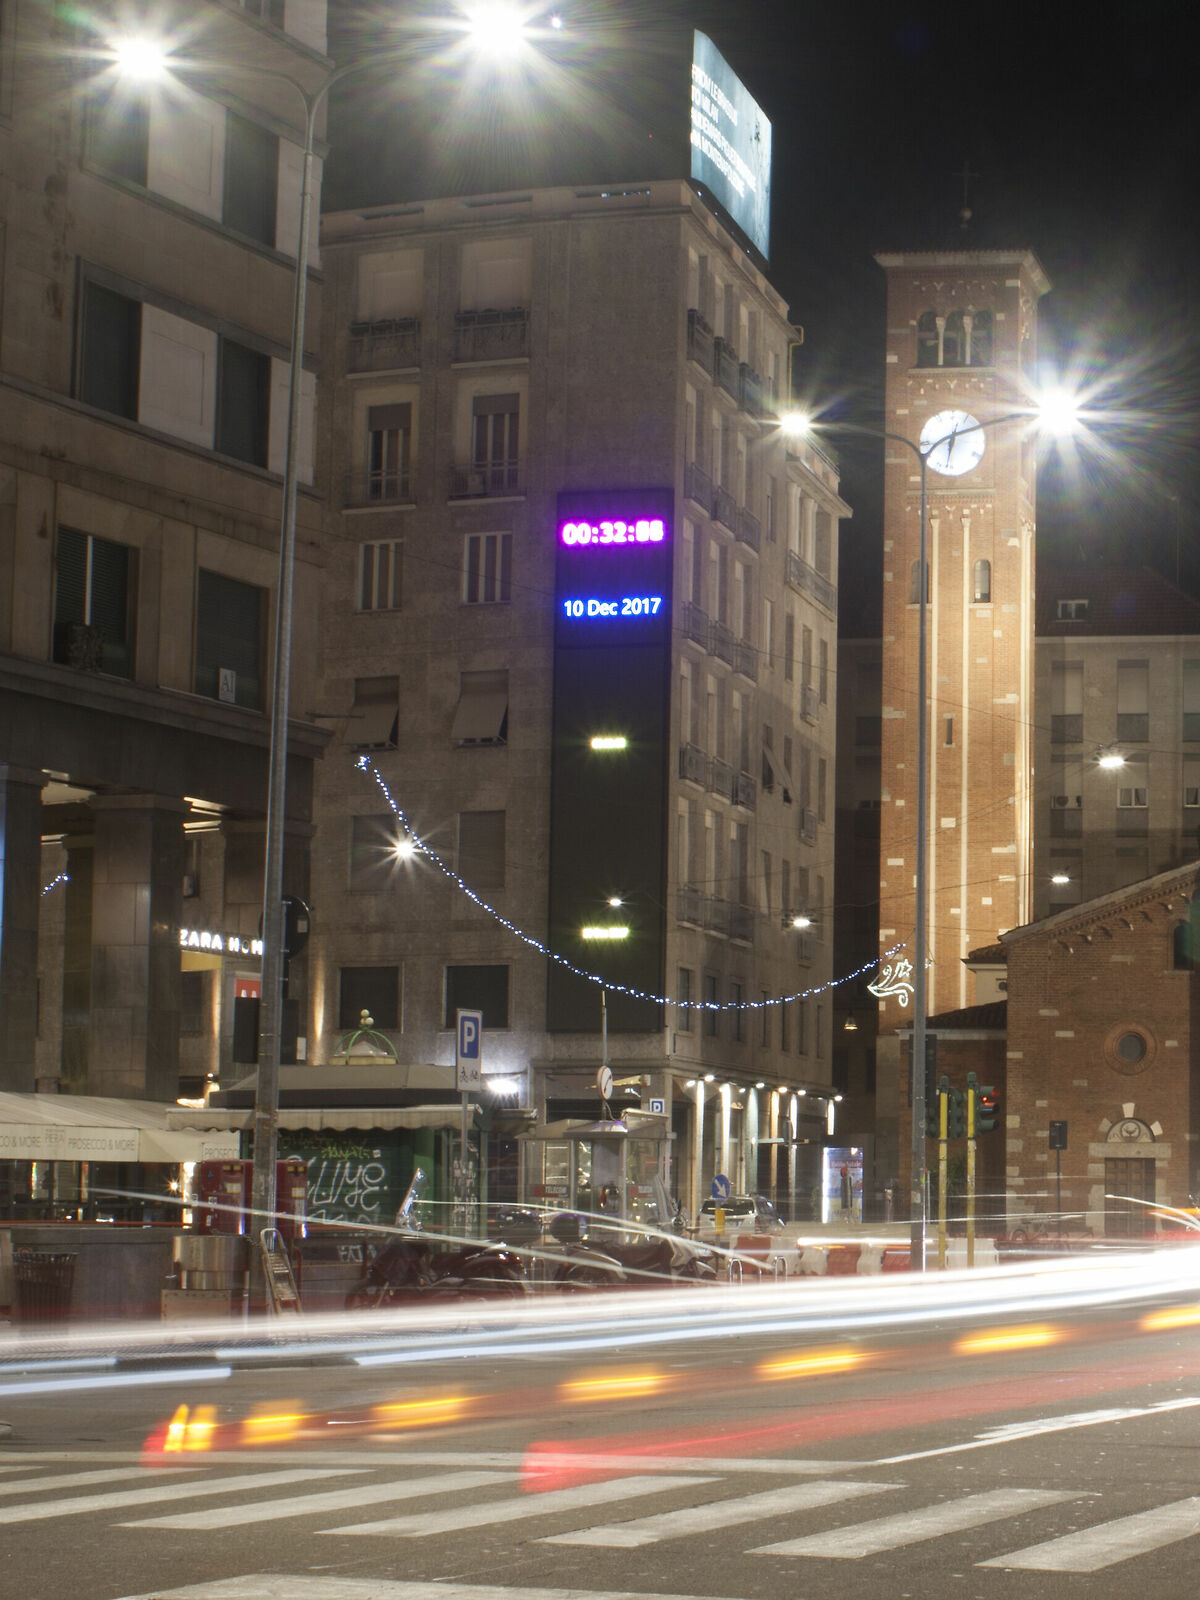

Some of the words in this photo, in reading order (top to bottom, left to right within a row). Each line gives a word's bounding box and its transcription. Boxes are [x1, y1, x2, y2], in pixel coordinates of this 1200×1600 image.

[564, 600, 584, 617] 10
[587, 600, 618, 616] Dec
[621, 598, 662, 614] 2017
[180, 929, 222, 950] ZARA
[463, 1021, 475, 1054] P
[68, 1137, 107, 1151] PROSECCO
[115, 1139, 136, 1151] MORE
